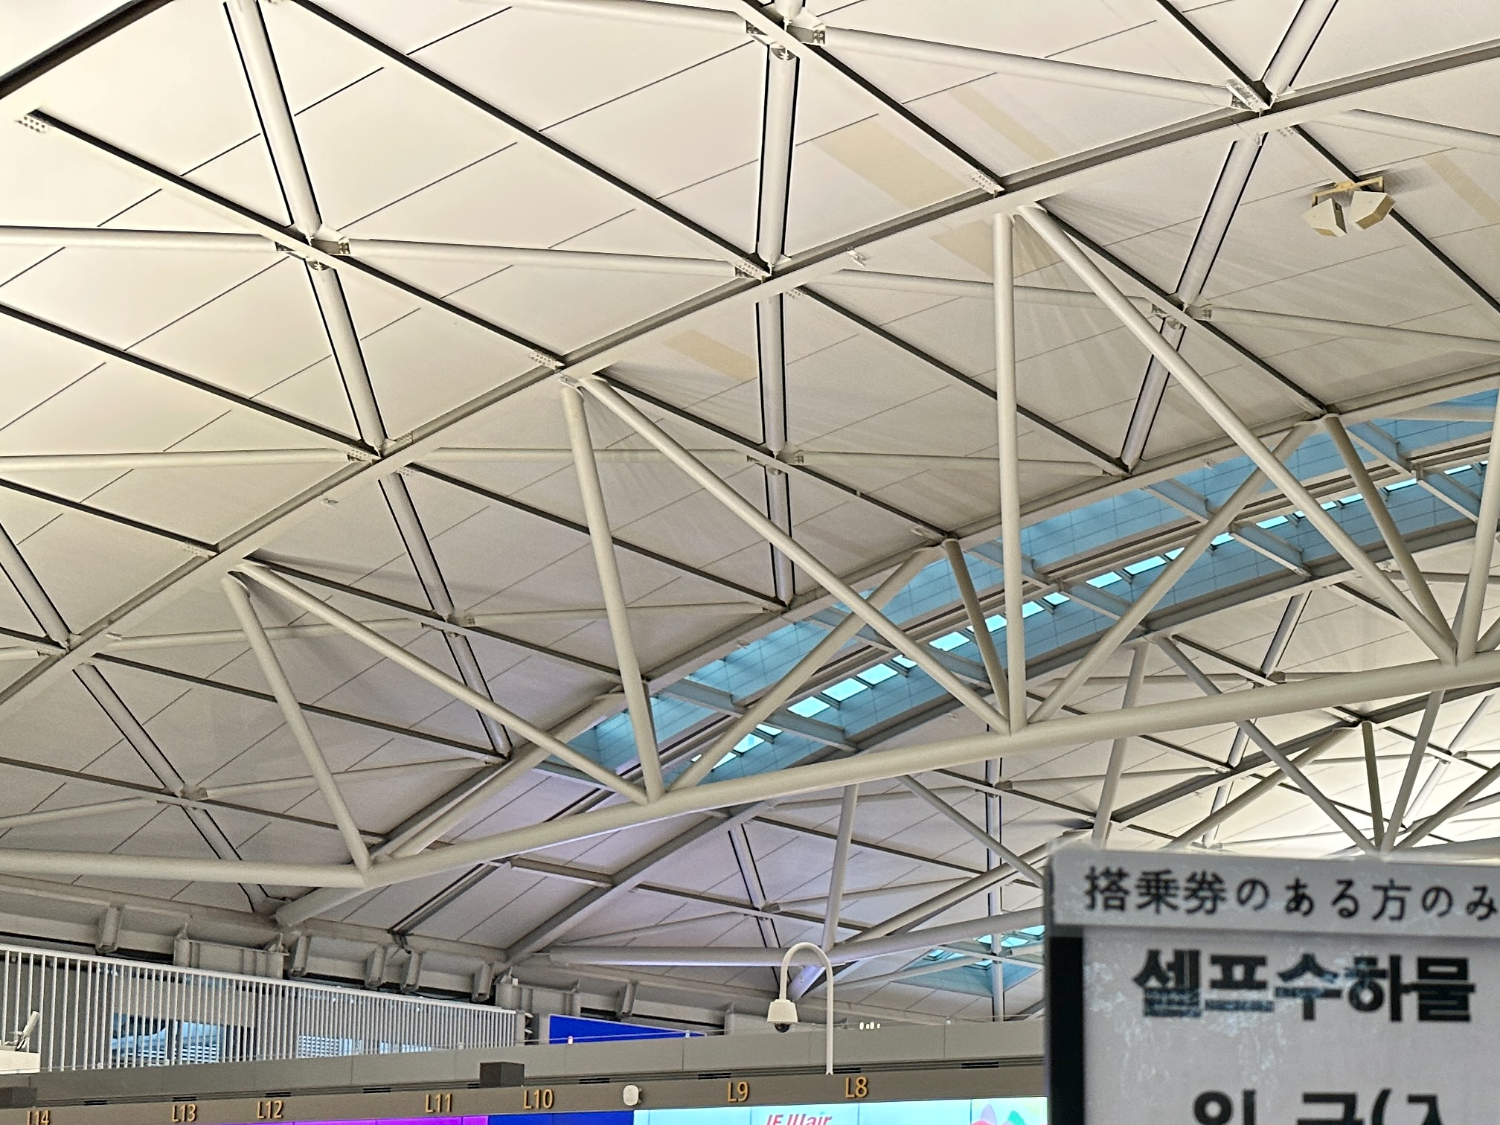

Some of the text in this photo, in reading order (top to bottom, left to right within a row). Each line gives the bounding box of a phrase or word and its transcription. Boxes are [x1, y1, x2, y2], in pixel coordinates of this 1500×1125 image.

[1131, 949, 1476, 1023] 셀프수하물
[726, 1080, 750, 1103] L9
[844, 1076, 870, 1099] L8
[256, 1100, 285, 1120] L12
[425, 1093, 453, 1114] L11
[523, 1089, 555, 1110] L10
[171, 1104, 198, 1123] L13
